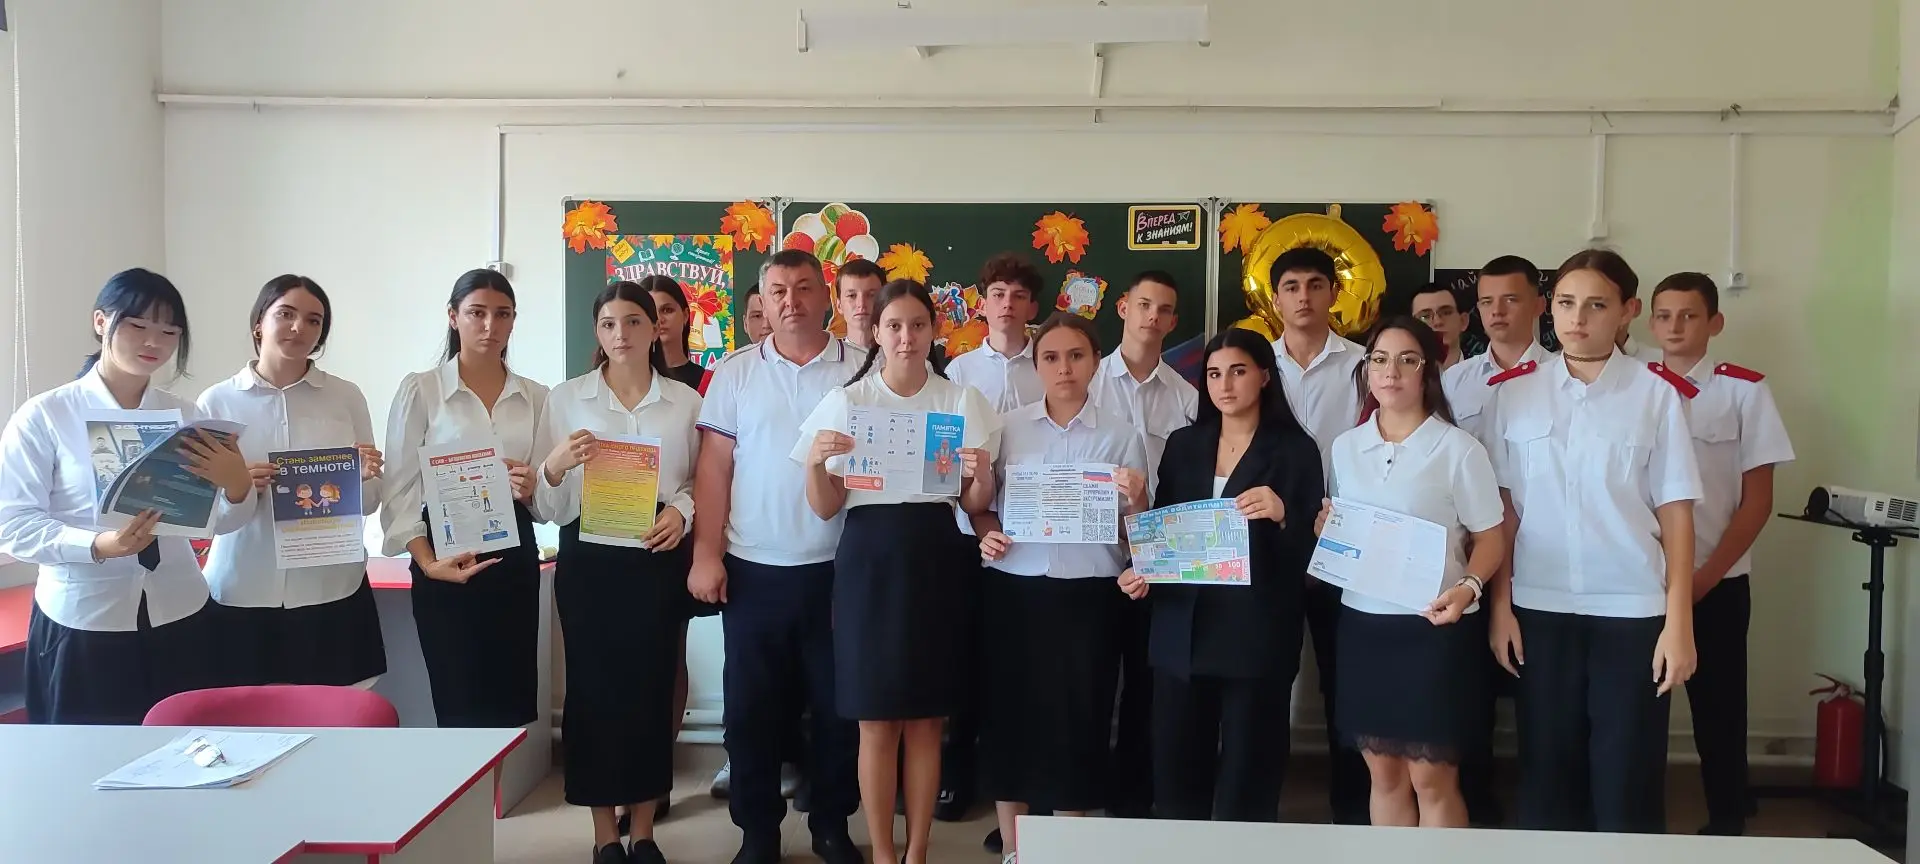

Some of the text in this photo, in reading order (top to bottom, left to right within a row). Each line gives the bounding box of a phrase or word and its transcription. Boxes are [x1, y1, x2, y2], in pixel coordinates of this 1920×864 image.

[1136, 222, 1193, 243] К ЗНАНИЯМ!
[615, 261, 725, 288] ЗДРАВСТВУЙ,
[932, 424, 961, 433] ПАМЯТКА
[276, 453, 353, 465] Стань заметнее
